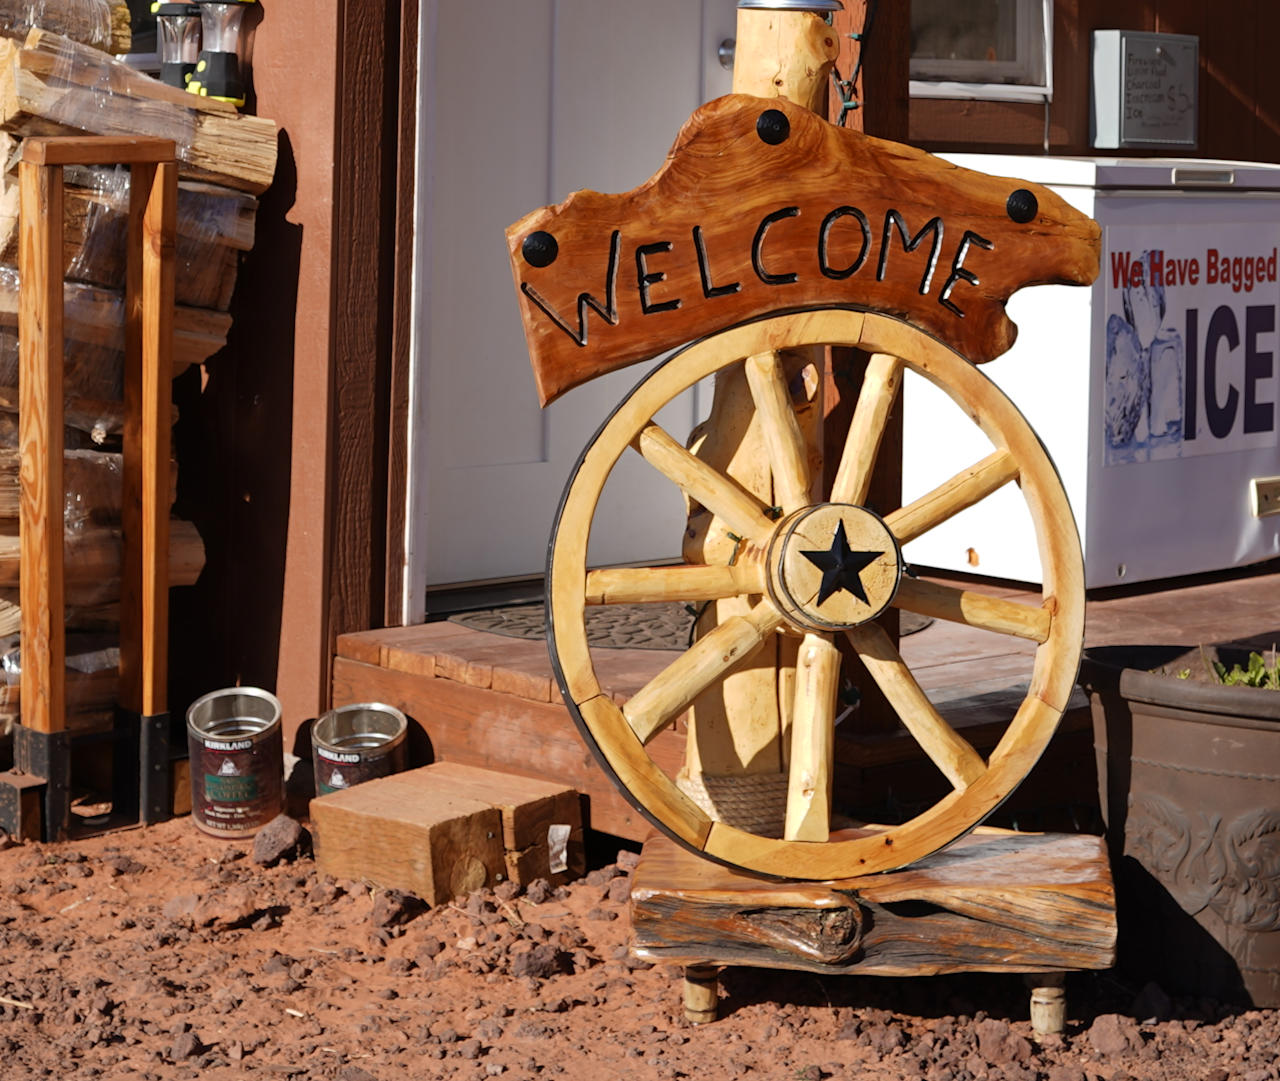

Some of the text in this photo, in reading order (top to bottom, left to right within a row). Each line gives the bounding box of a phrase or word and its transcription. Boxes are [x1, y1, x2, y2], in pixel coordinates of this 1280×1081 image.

[521, 205, 995, 347] WELCOME
[1110, 247, 1278, 293] We Have Bagged
[1183, 304, 1276, 441] ICE
[204, 740, 253, 751] KIRKLAND
